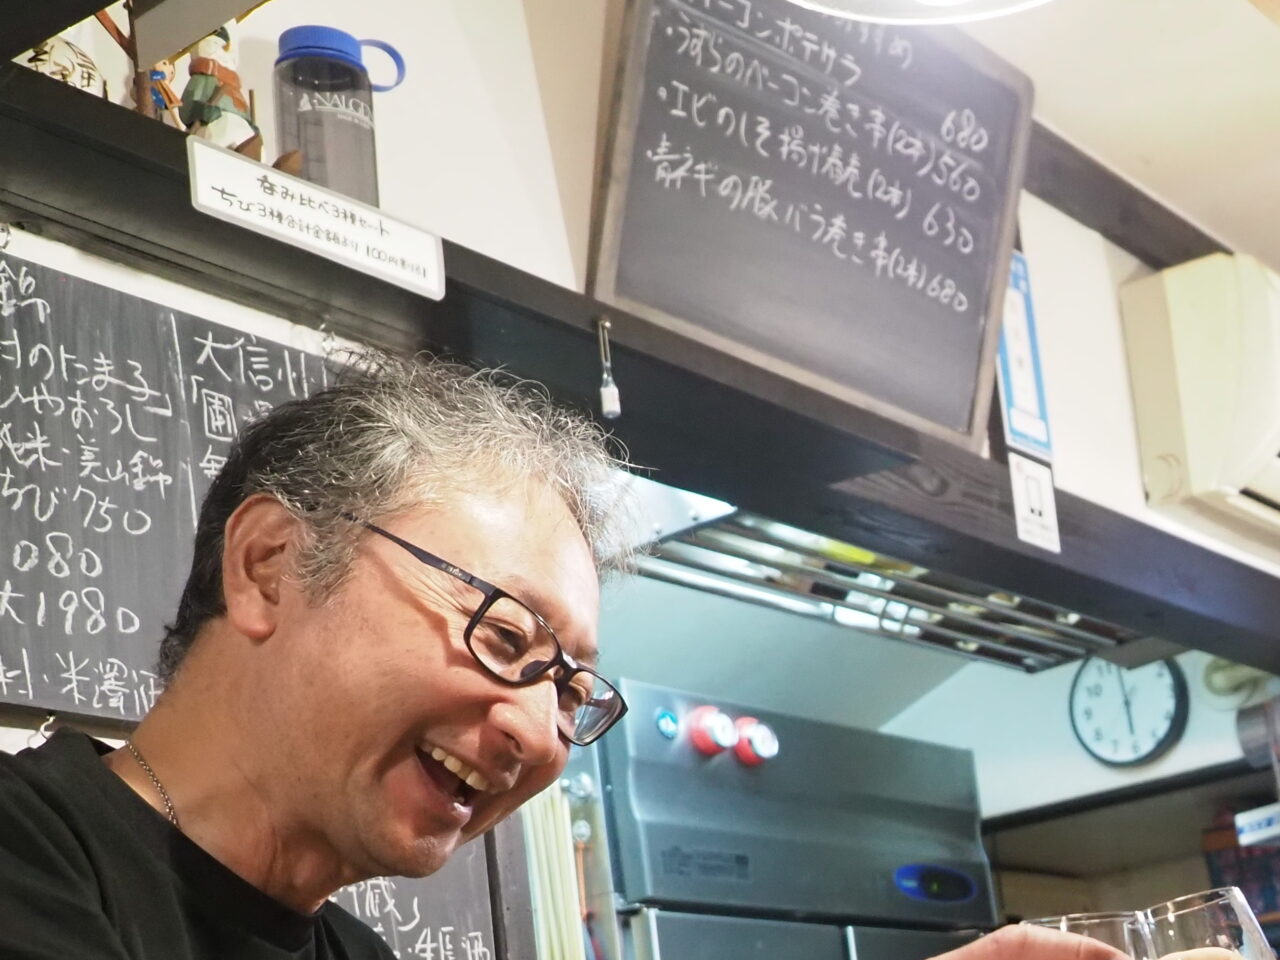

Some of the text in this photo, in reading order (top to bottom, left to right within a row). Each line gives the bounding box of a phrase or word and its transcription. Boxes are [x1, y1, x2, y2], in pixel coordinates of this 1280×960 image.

[940, 108, 989, 151] 680
[931, 151, 981, 201] 560
[922, 202, 974, 254] 630
[925, 274, 968, 312] 680
[193, 331, 329, 399] 大信州
[72, 484, 152, 535] 750
[37, 586, 140, 636] 1980
